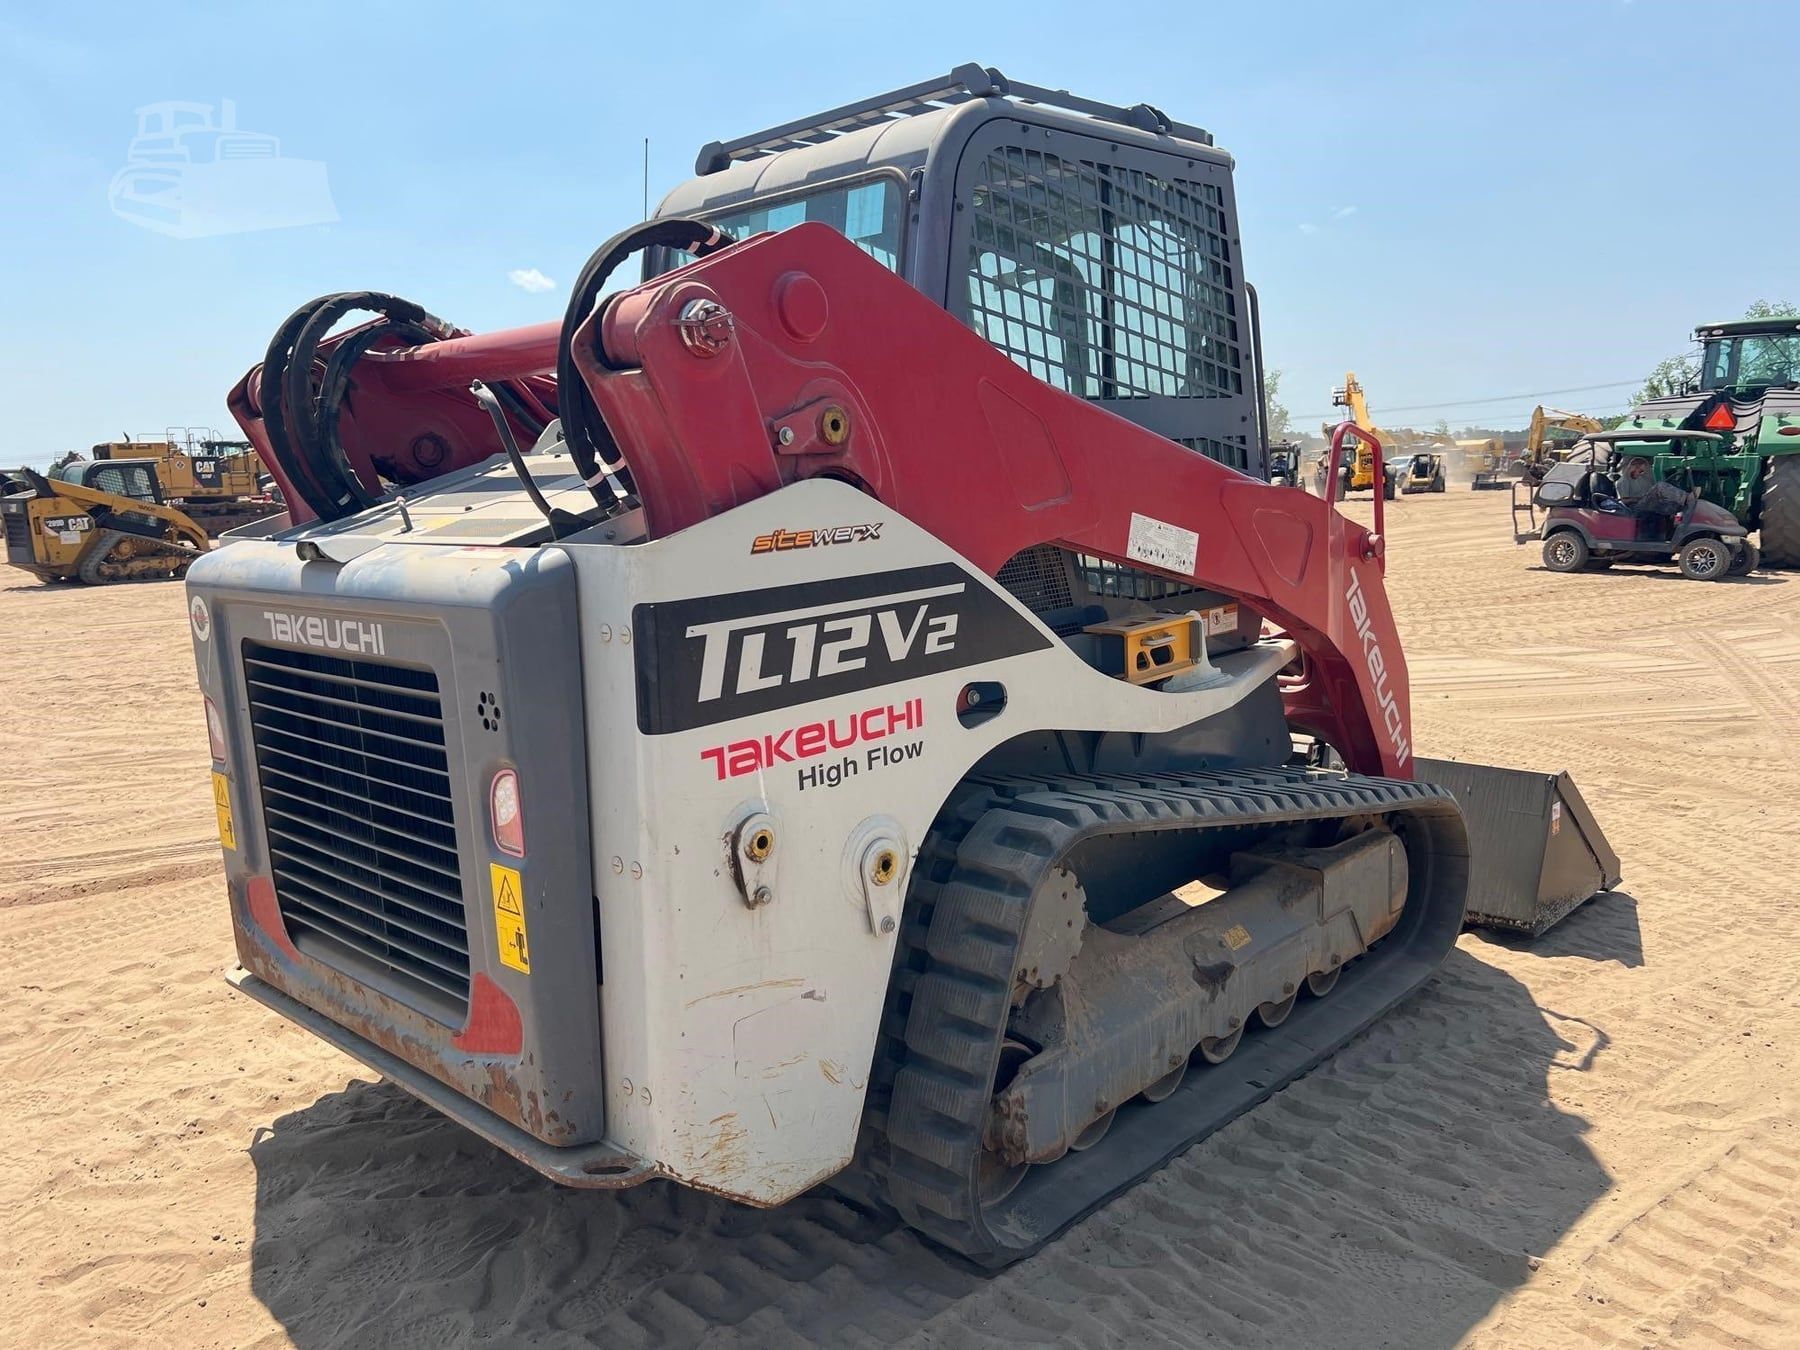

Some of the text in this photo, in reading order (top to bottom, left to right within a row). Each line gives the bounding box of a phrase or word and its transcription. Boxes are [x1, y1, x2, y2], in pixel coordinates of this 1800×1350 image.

[195, 461, 215, 473] CAT
[68, 518, 89, 531] CAT
[263, 611, 385, 656] TAKEUCHI
[685, 582, 966, 703] TL12V2
[1346, 566, 1409, 768] TAKEUCHI
[700, 698, 924, 781] TAKEUCHI
[798, 740, 924, 791] High Flow
